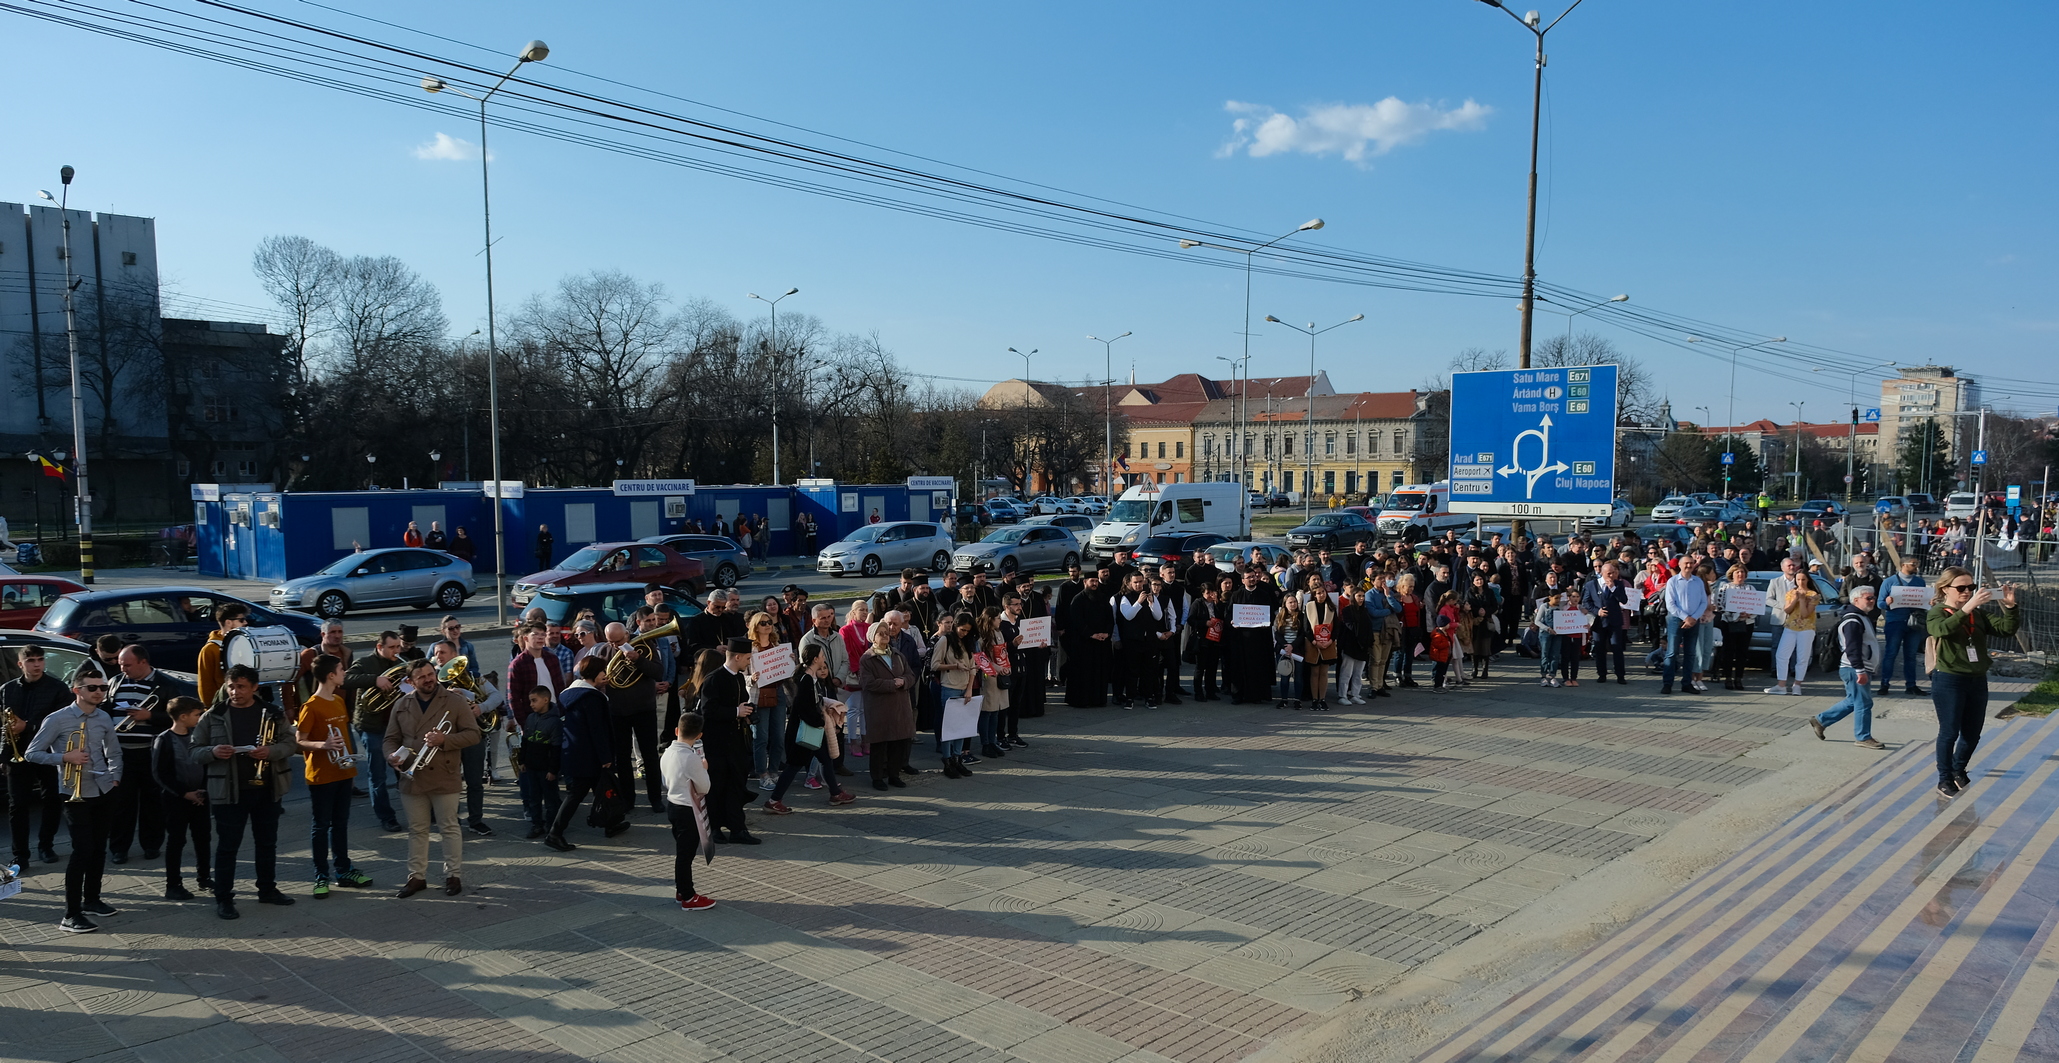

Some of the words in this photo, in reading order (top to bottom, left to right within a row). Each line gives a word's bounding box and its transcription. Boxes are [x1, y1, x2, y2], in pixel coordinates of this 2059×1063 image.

[1513, 373, 1533, 383] Satu
[1536, 372, 1559, 382] Mare
[1569, 371, 1588, 381] E671
[1513, 387, 1541, 398] Ártánd
[1549, 388, 1556, 398] H
[1570, 387, 1576, 396] E
[1577, 387, 1587, 396] 60
[1513, 403, 1536, 412] Vama
[1570, 402, 1575, 411] E
[1576, 403, 1586, 411] 60
[1454, 454, 1473, 463] Arad
[1454, 467, 1480, 476] Aeroport
[1576, 464, 1581, 473] E
[1583, 465, 1592, 473] 60
[656, 483, 689, 491] VACCINARE
[1454, 483, 1480, 491] Centru
[1555, 477, 1573, 490] Cluj
[1576, 478, 1610, 490] Napoca
[1512, 504, 1529, 514] 100
[1533, 506, 1541, 514] m
[758, 651, 775, 659] FIECARE
[770, 662, 789, 670] DREPTUL
